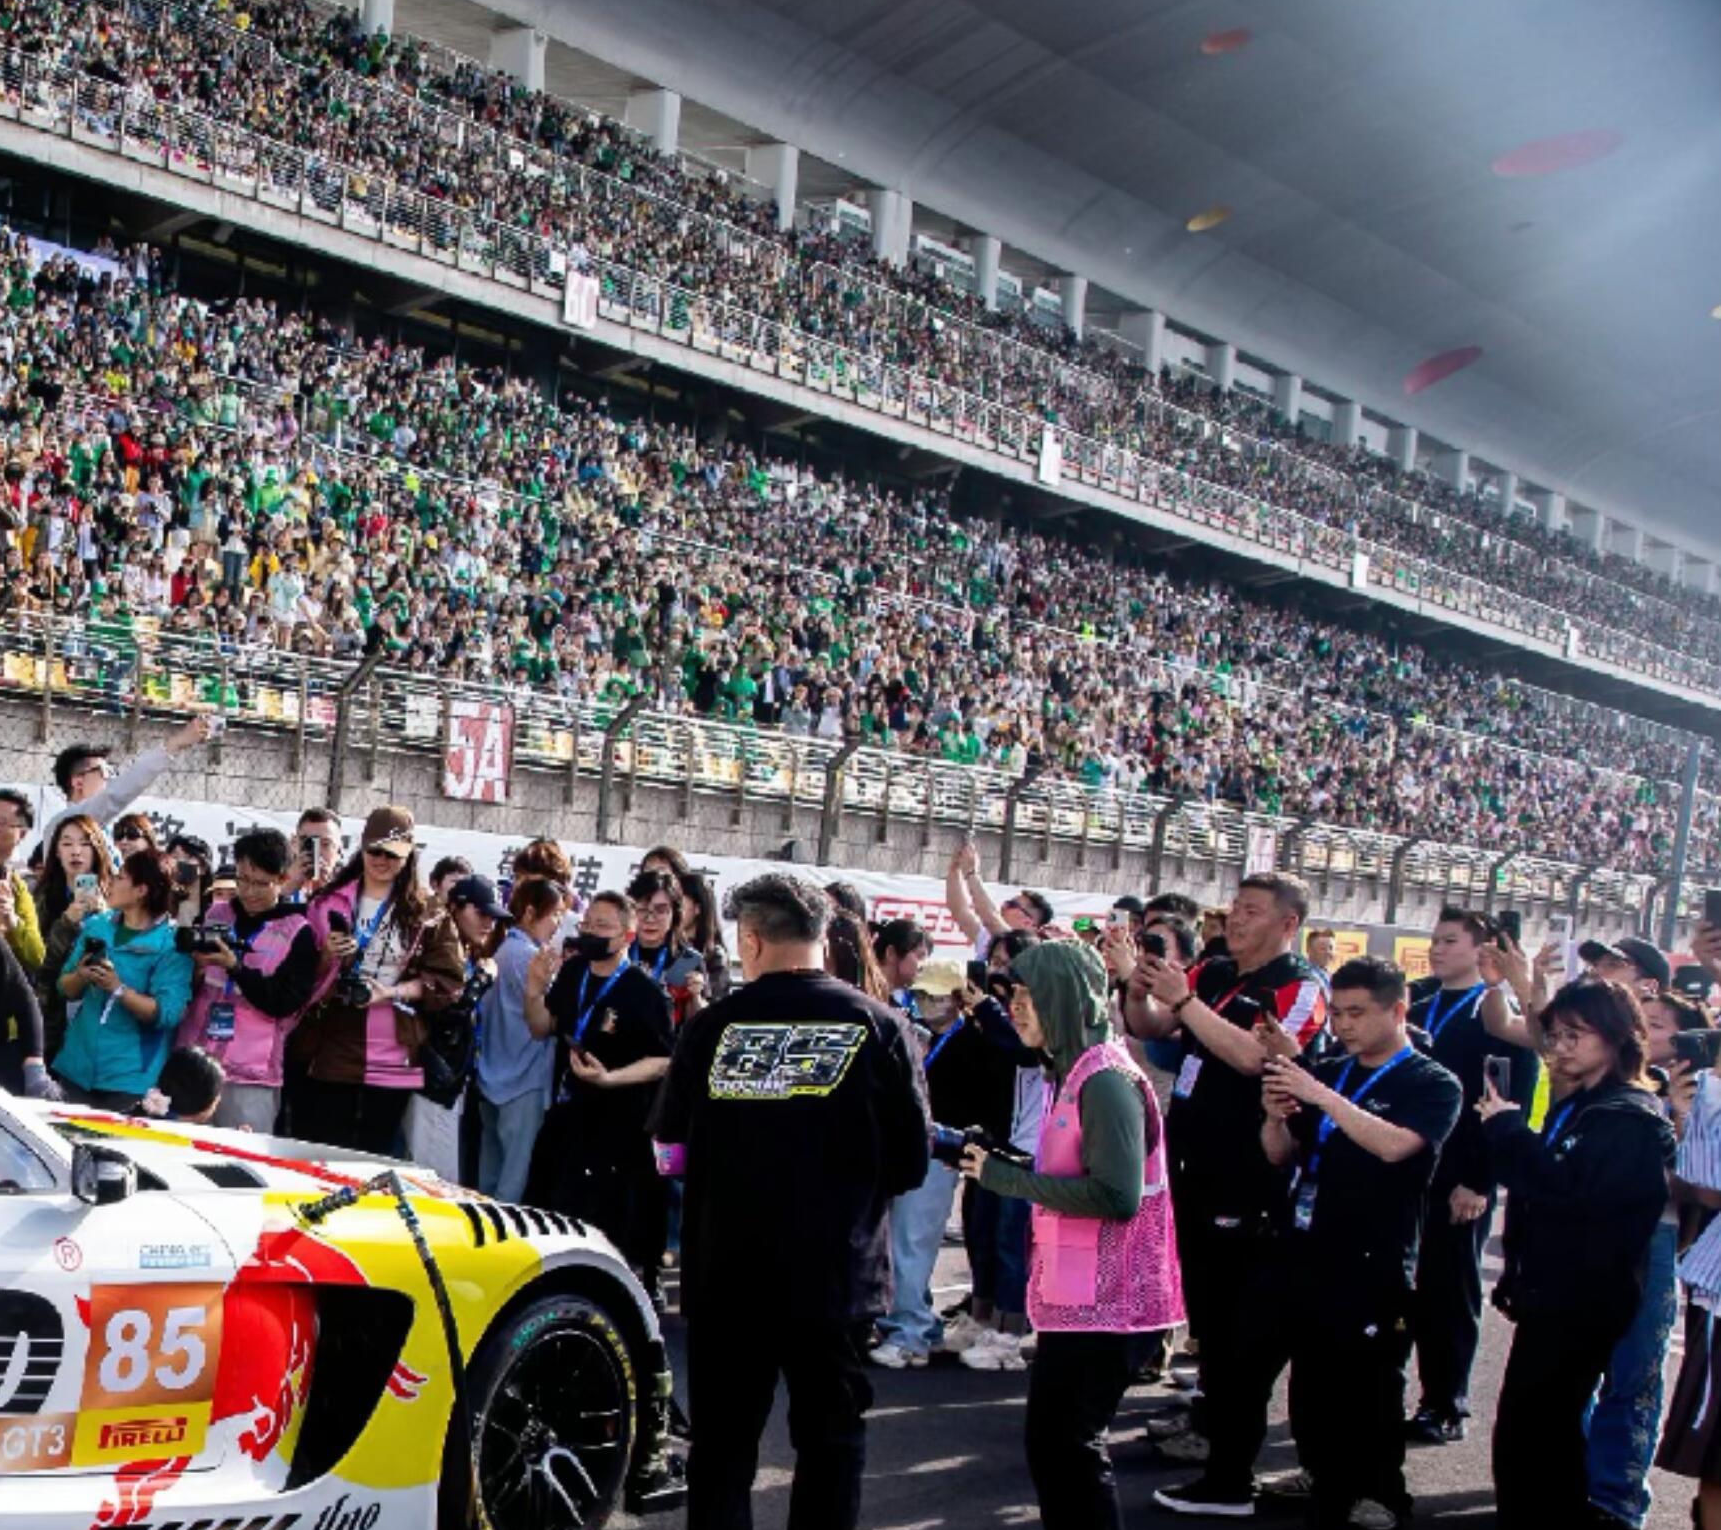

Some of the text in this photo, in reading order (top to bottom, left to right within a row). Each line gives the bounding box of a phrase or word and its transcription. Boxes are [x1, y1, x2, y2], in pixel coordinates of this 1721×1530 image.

[444, 701, 507, 803] 5A
[99, 1307, 207, 1392] 85
[2, 1424, 66, 1461] GT3
[97, 1416, 188, 1450] PIRELLI
